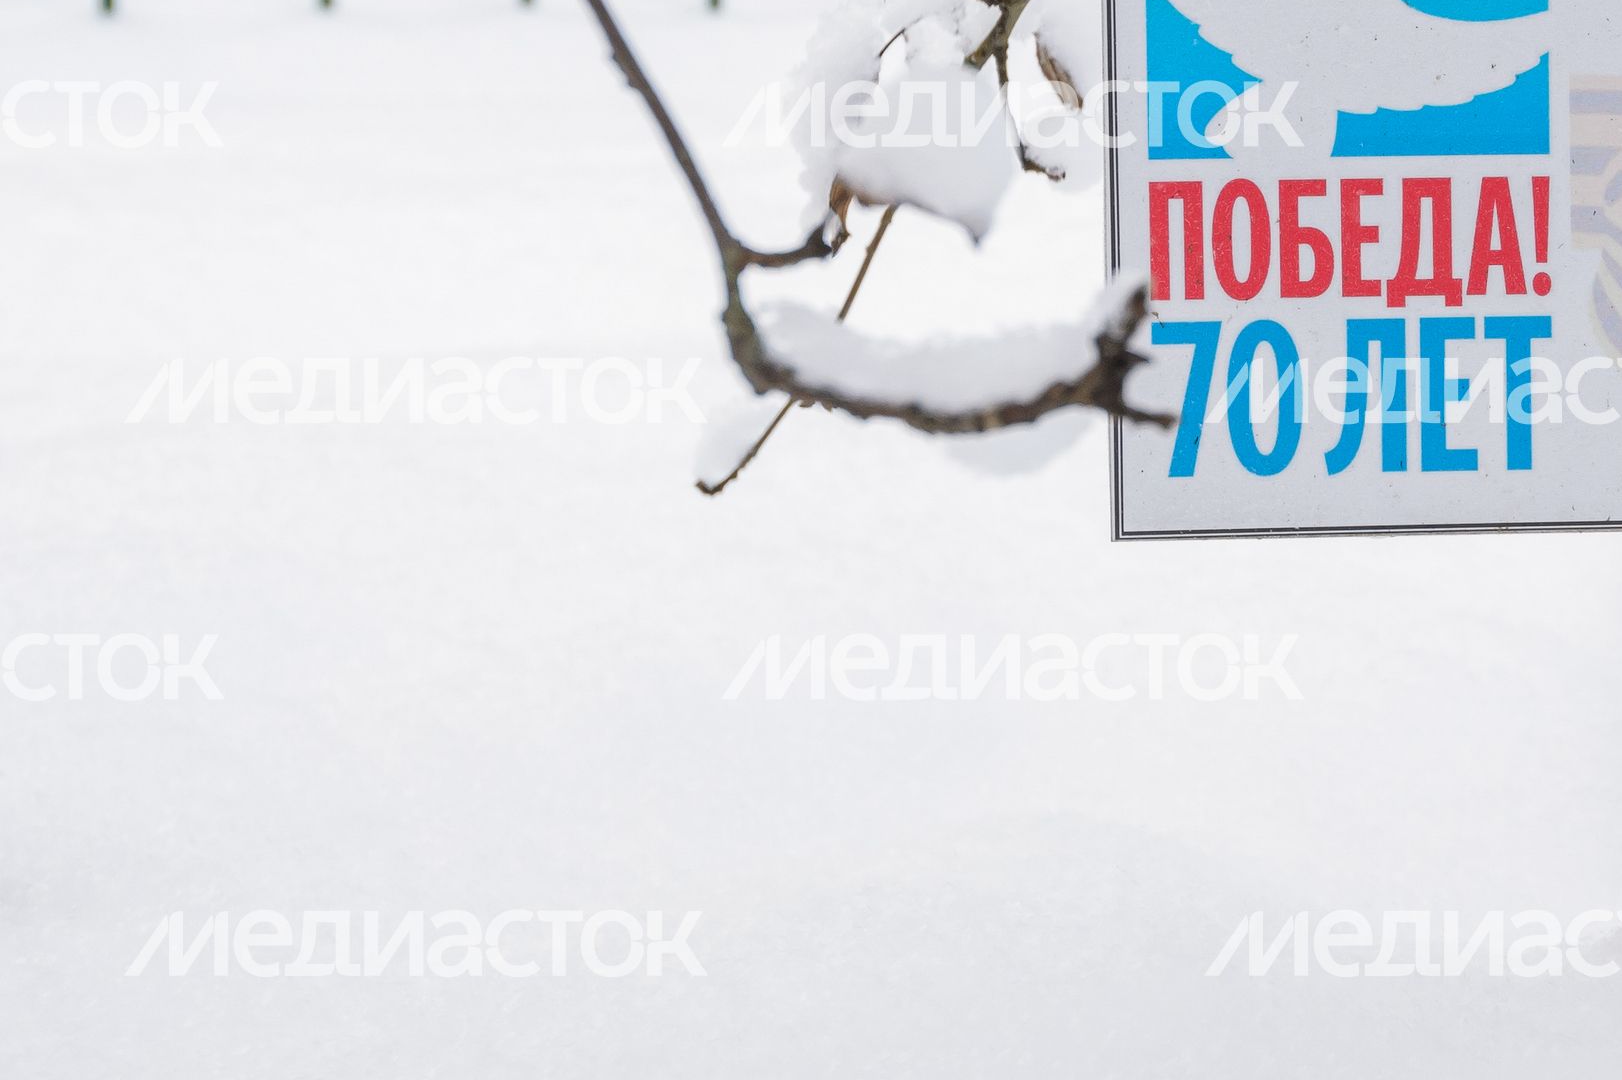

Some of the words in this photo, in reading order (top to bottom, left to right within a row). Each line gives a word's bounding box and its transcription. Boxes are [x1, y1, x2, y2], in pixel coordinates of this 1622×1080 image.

[1148, 175, 1552, 309] ПОБЕДА!
[1150, 318, 1304, 479] 70
[1322, 314, 1553, 477] ЛЕТ
